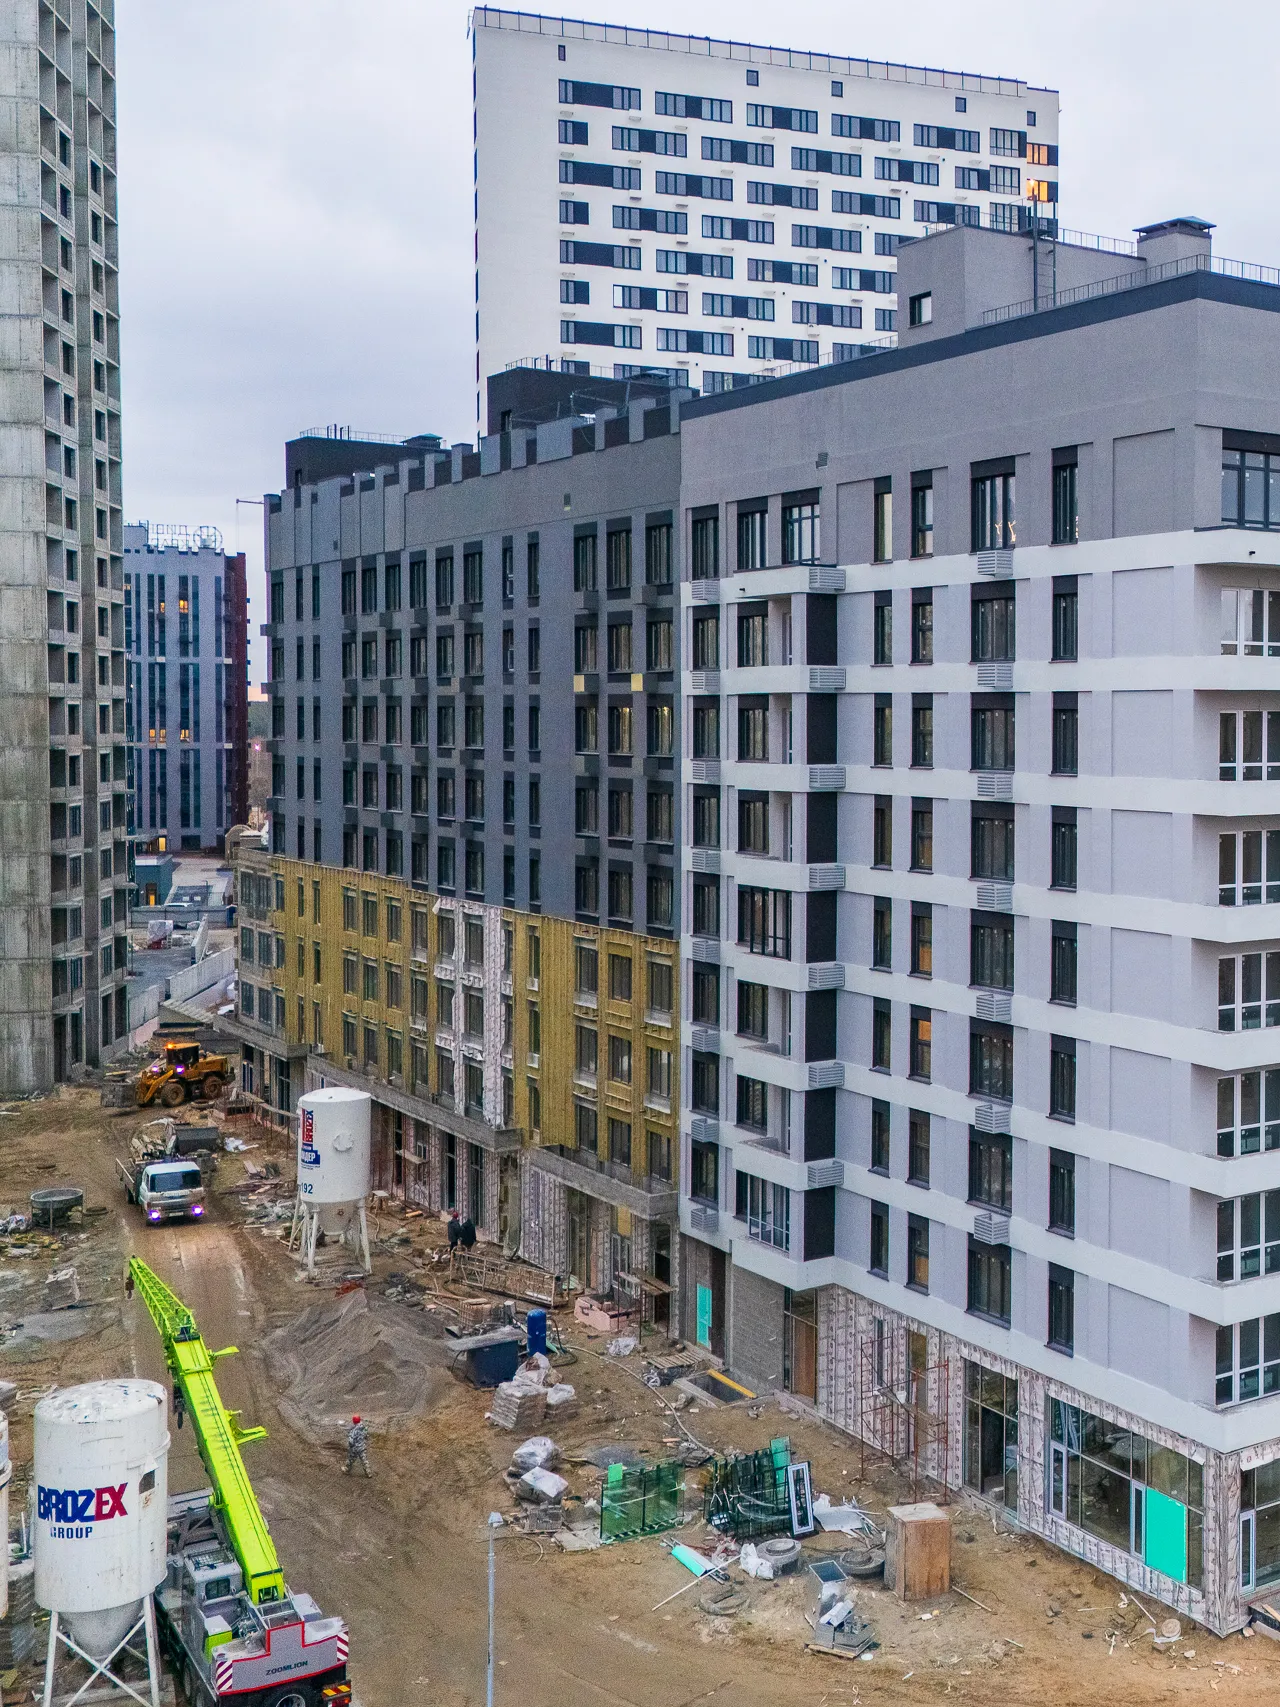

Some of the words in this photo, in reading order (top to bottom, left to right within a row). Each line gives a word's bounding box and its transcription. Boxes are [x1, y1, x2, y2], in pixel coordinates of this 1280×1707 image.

[38, 1482, 128, 1523] BROZEX
[51, 1526, 93, 1540] GROUP
[266, 1660, 308, 1676] ZOOMLION
